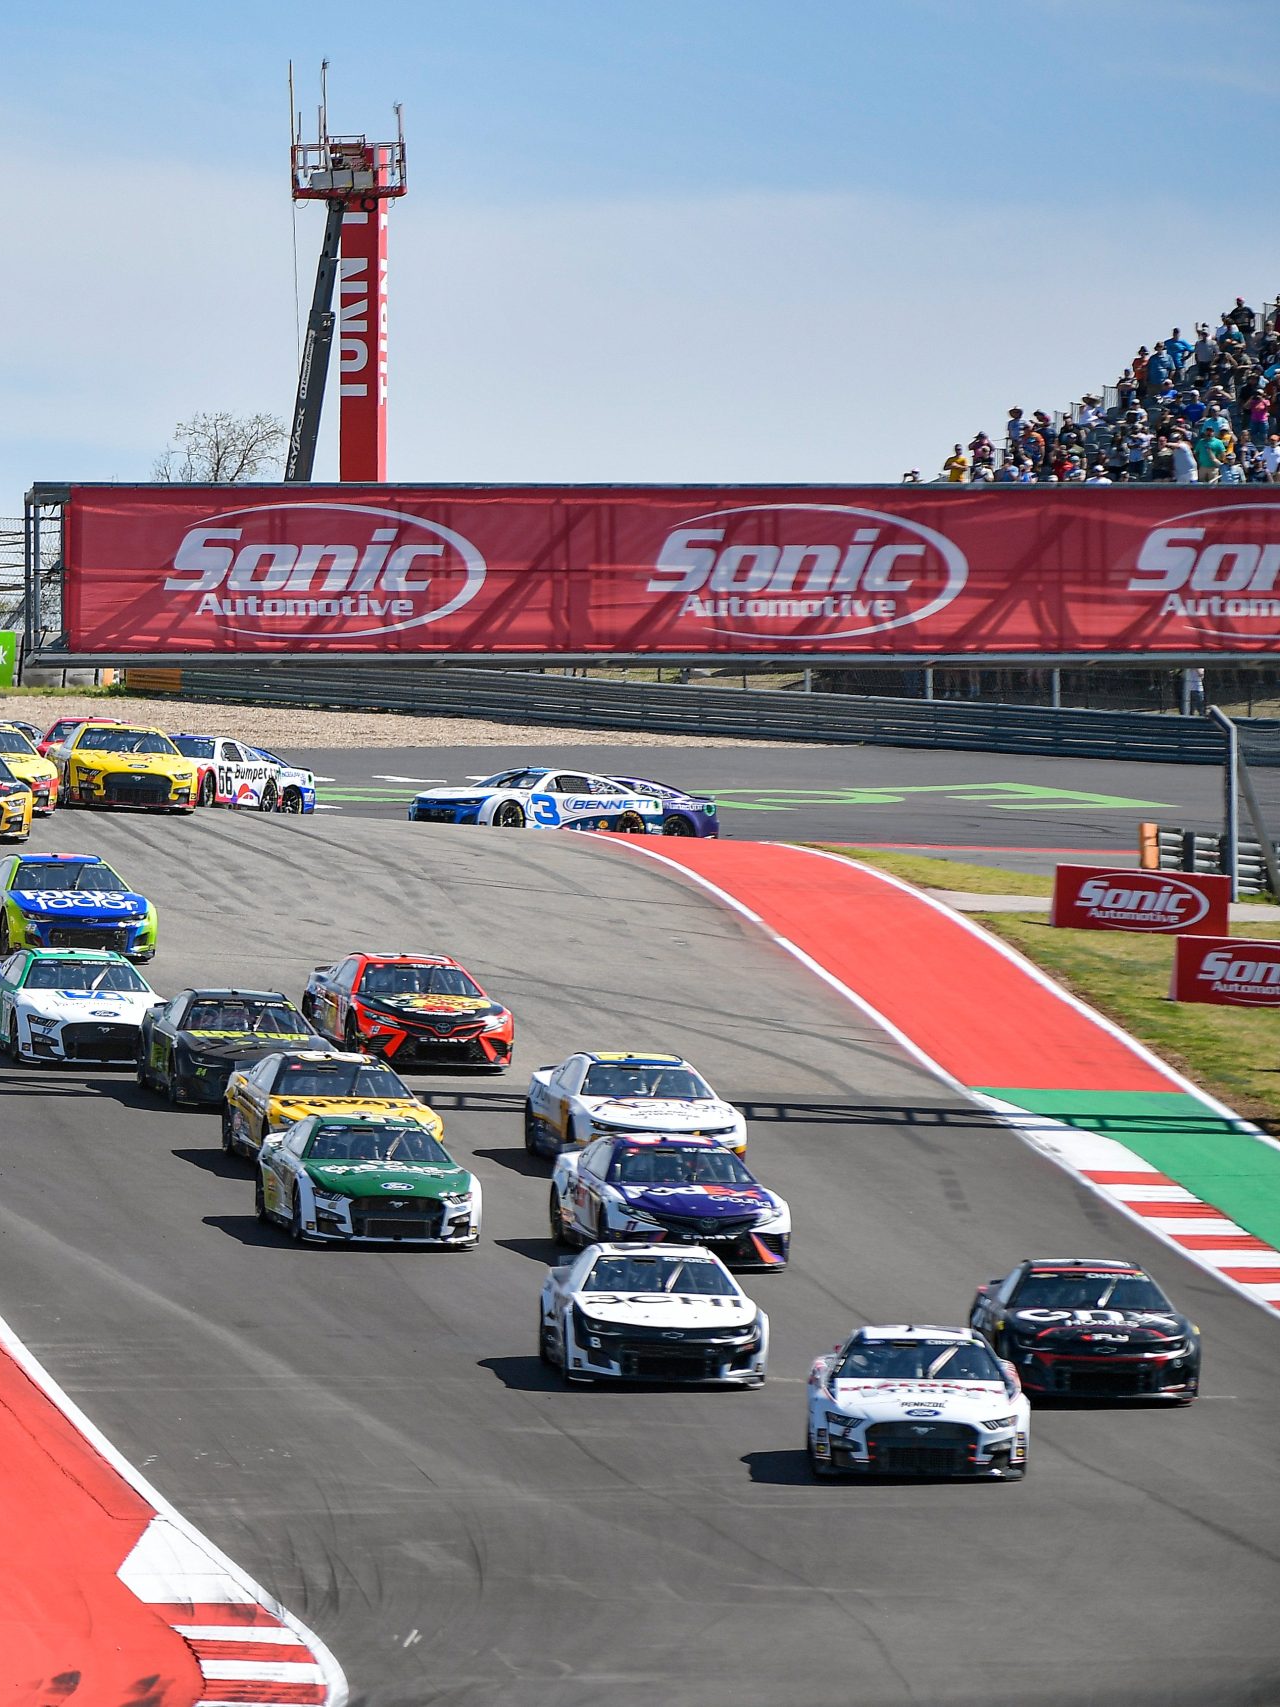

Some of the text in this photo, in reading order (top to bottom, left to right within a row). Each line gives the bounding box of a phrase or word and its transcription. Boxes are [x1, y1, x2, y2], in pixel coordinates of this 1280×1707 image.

[288, 407, 306, 480] SKYJACK
[164, 528, 445, 591] Sonic
[646, 528, 926, 592] Sonic
[195, 593, 414, 616] Automotive
[679, 594, 896, 617] Automotive
[218, 765, 233, 796] 66
[531, 793, 561, 826] 3
[572, 799, 653, 810] BENNETT
[1074, 880, 1193, 913] Sonic
[1087, 907, 1180, 924] Automotive
[620, 1183, 765, 1200] FedEx
[708, 1194, 773, 1209] Ground
[590, 1336, 602, 1349] 8
